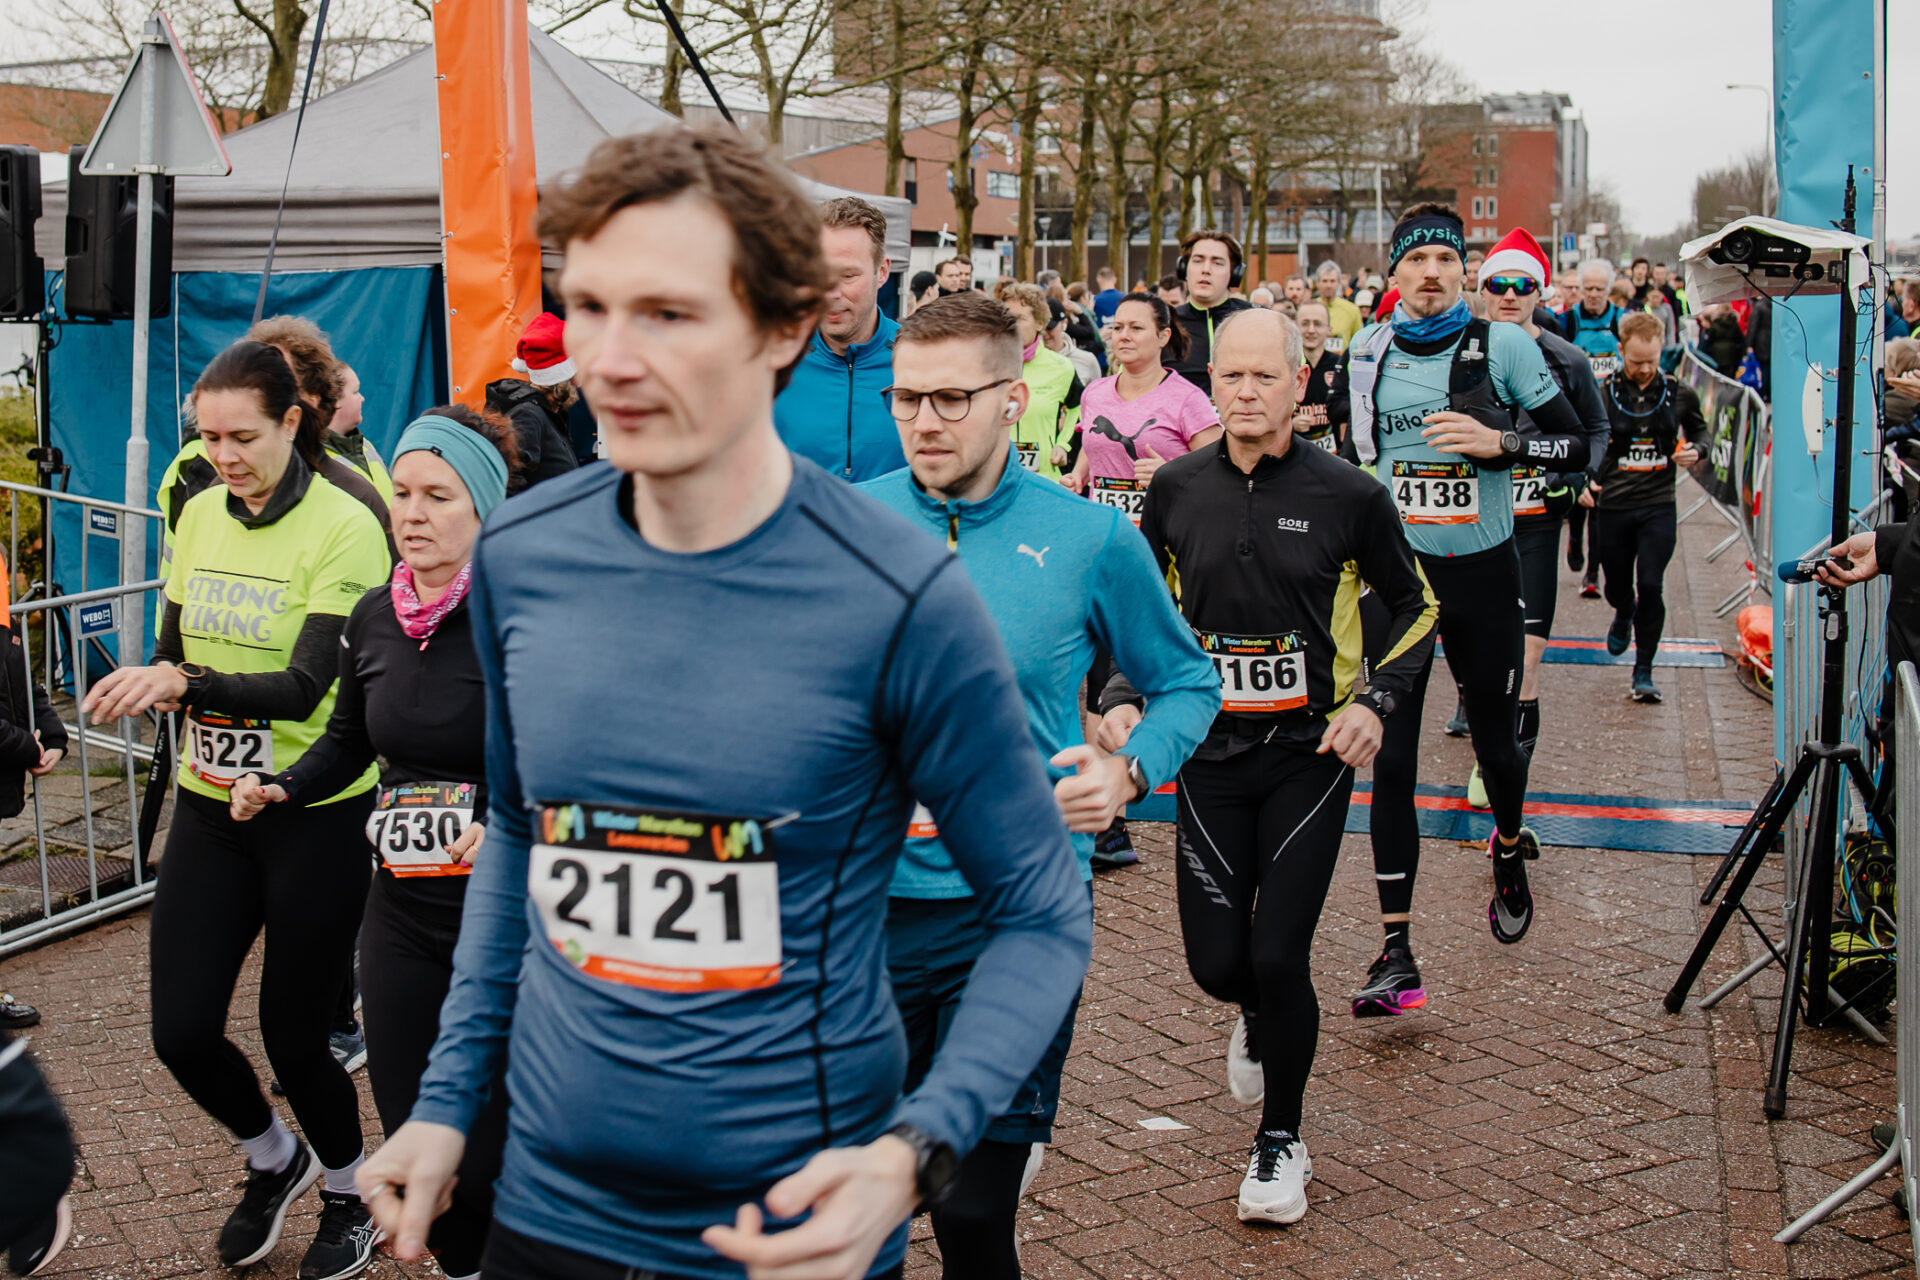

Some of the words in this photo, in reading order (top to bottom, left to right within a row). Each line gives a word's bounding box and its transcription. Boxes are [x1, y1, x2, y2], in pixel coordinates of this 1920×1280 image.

[1528, 438, 1570, 460] BEAT
[1096, 491, 1145, 514] 1532
[1397, 480, 1472, 508] 4138
[92, 514, 108, 525] WEBO
[1278, 517, 1310, 529] GORE
[187, 576, 288, 615] STRONG
[82, 611, 103, 624] WEBO
[183, 603, 271, 643] VIKING
[1222, 637, 1241, 646] Winter
[191, 724, 264, 768] 1522
[374, 811, 462, 853] 1530
[549, 858, 743, 944] 2121
